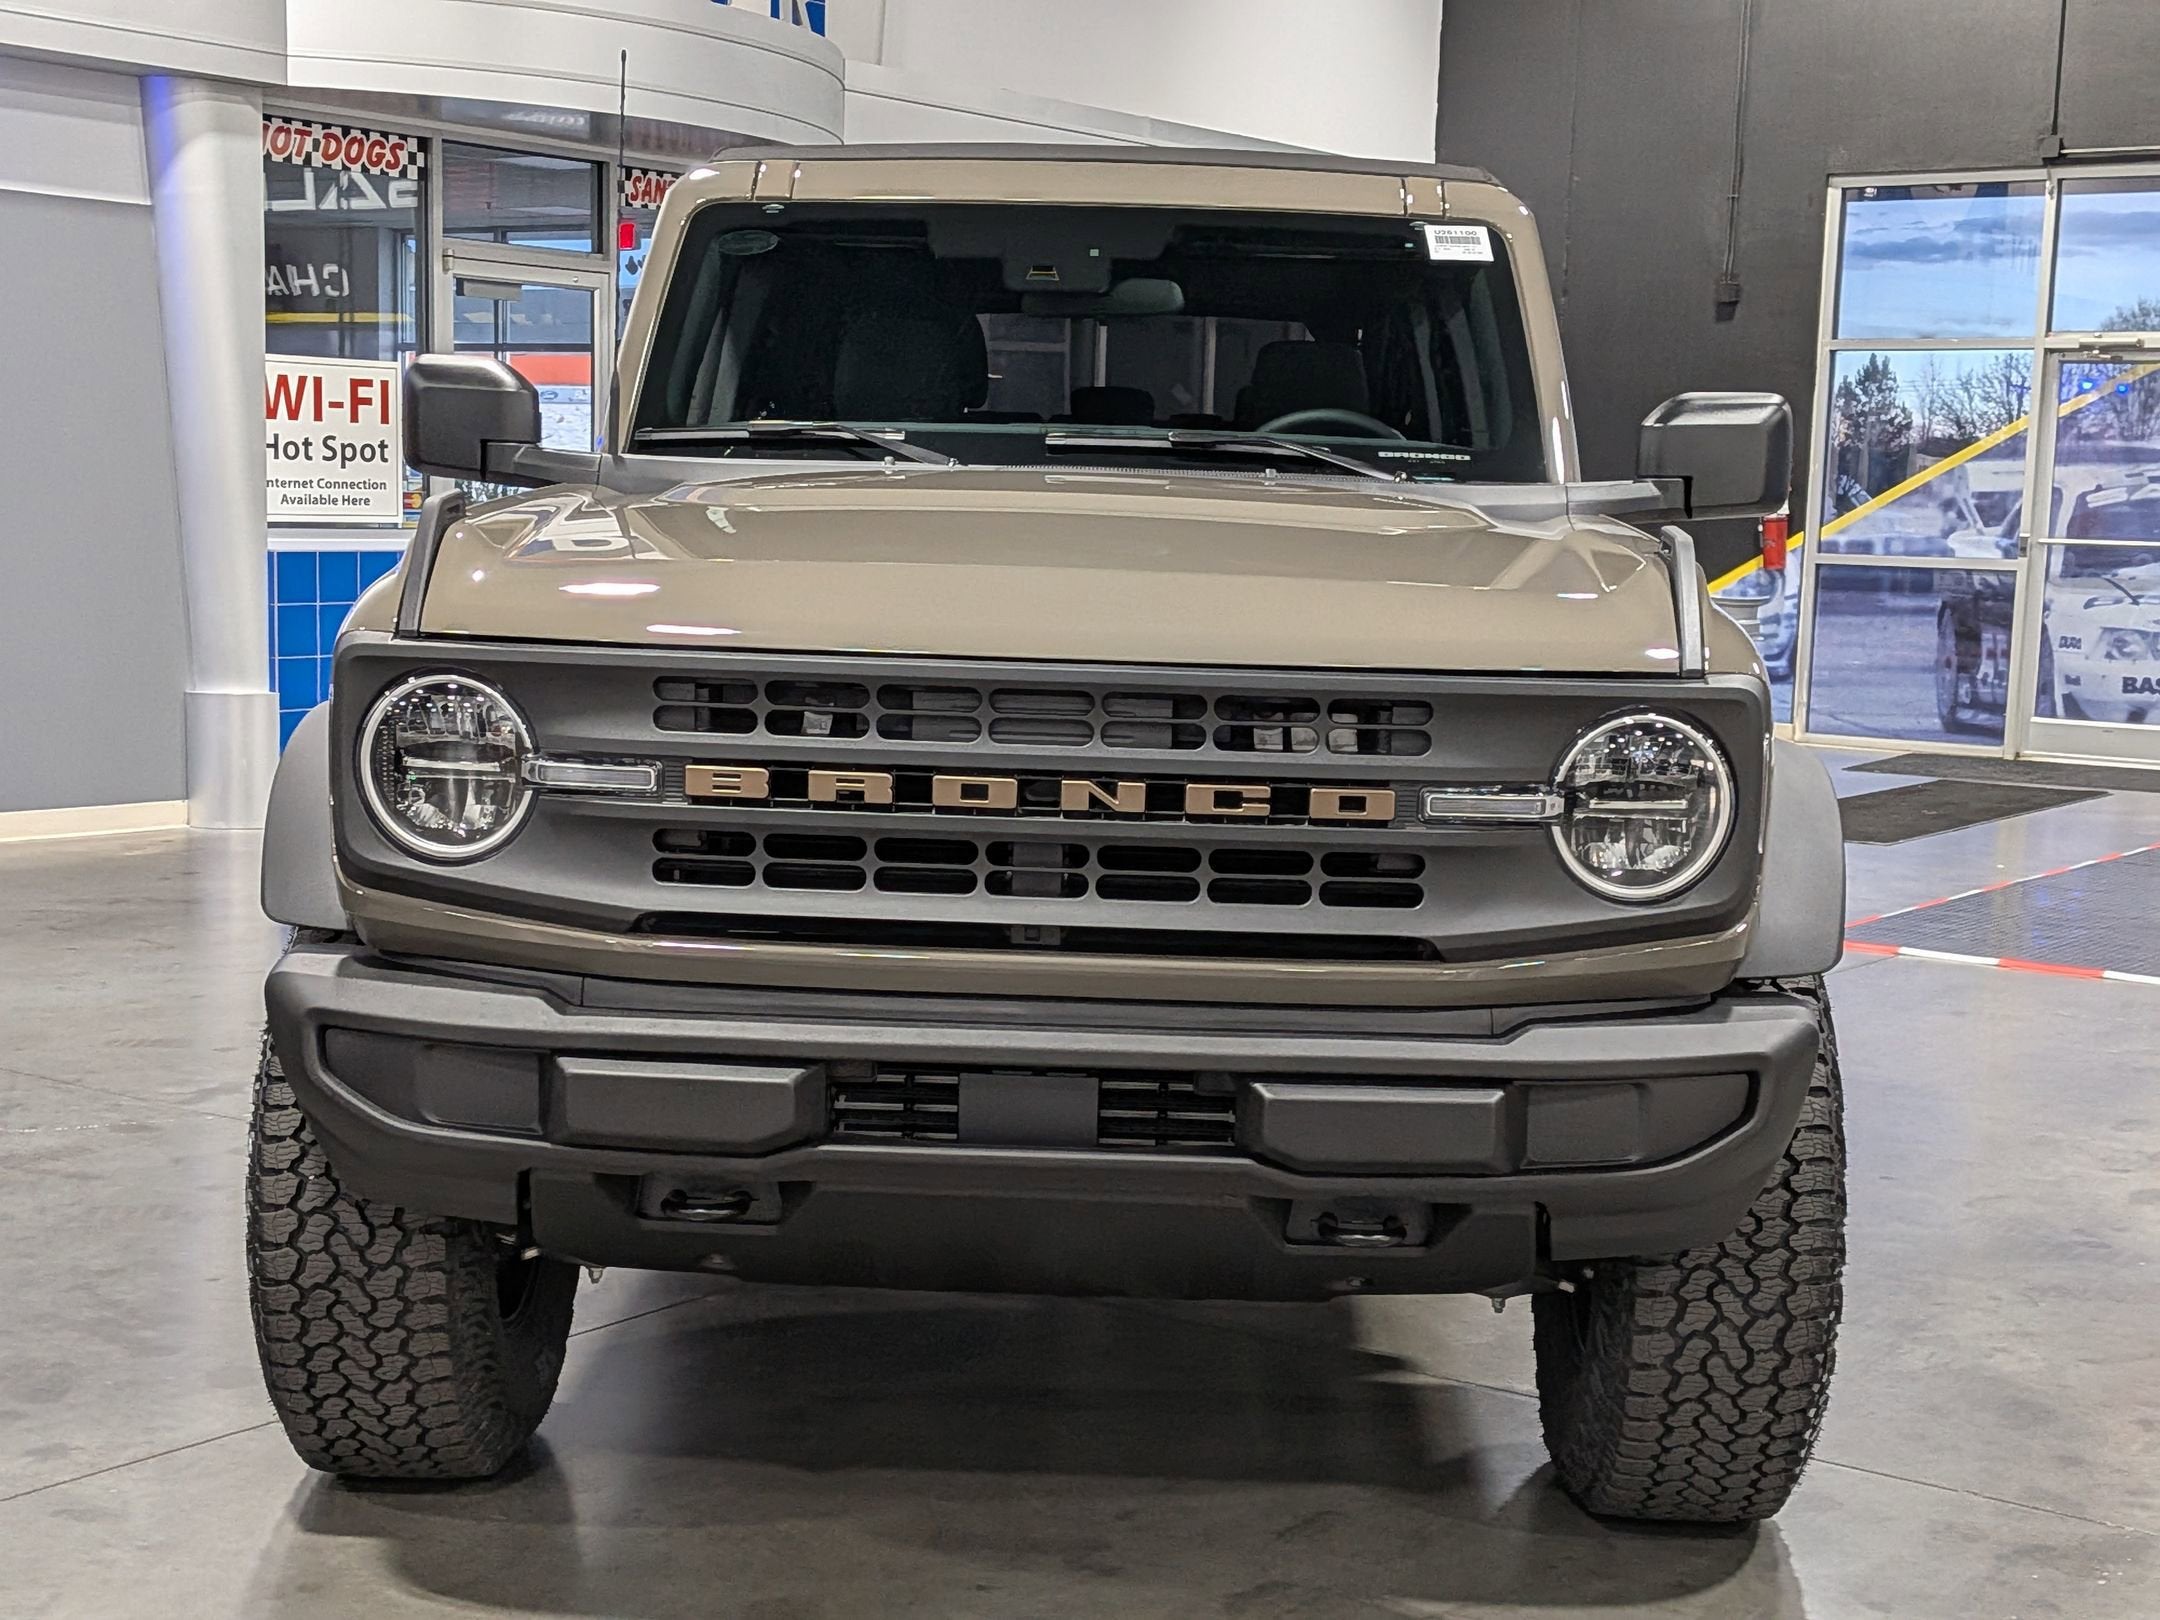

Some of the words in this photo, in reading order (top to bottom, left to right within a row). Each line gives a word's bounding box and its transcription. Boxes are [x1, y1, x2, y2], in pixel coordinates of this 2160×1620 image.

[320, 131, 406, 171] DOGS
[630, 175, 675, 204] SAN
[265, 374, 389, 424] WI-FI
[266, 433, 313, 461] Hot
[322, 435, 389, 469] Spot
[266, 478, 314, 489] nternet
[316, 478, 387, 490] Connection
[280, 494, 339, 506] Available
[342, 495, 371, 506] Here
[685, 764, 1396, 821] BRONCO
